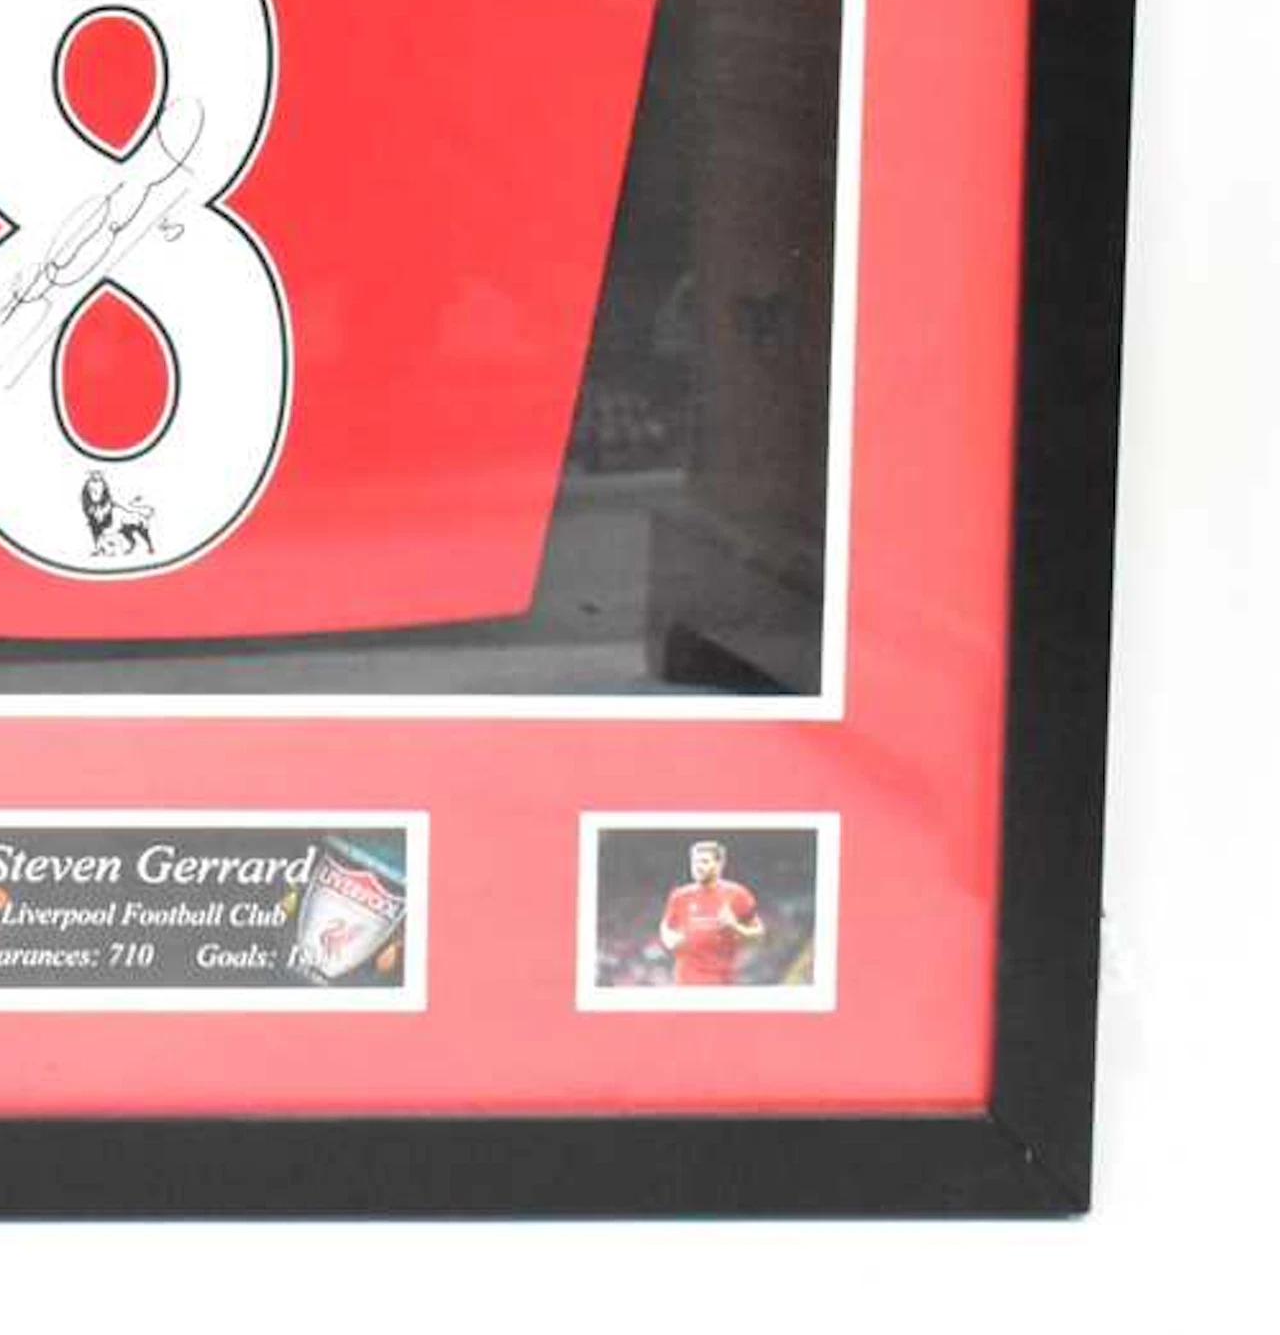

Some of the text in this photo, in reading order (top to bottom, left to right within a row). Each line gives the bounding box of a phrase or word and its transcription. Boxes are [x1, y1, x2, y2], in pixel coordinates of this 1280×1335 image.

[136, 843, 317, 885] Gerrard
[0, 901, 287, 931] Liverpool Football Club
[109, 942, 155, 968] 710
[195, 942, 278, 969] Goals:
